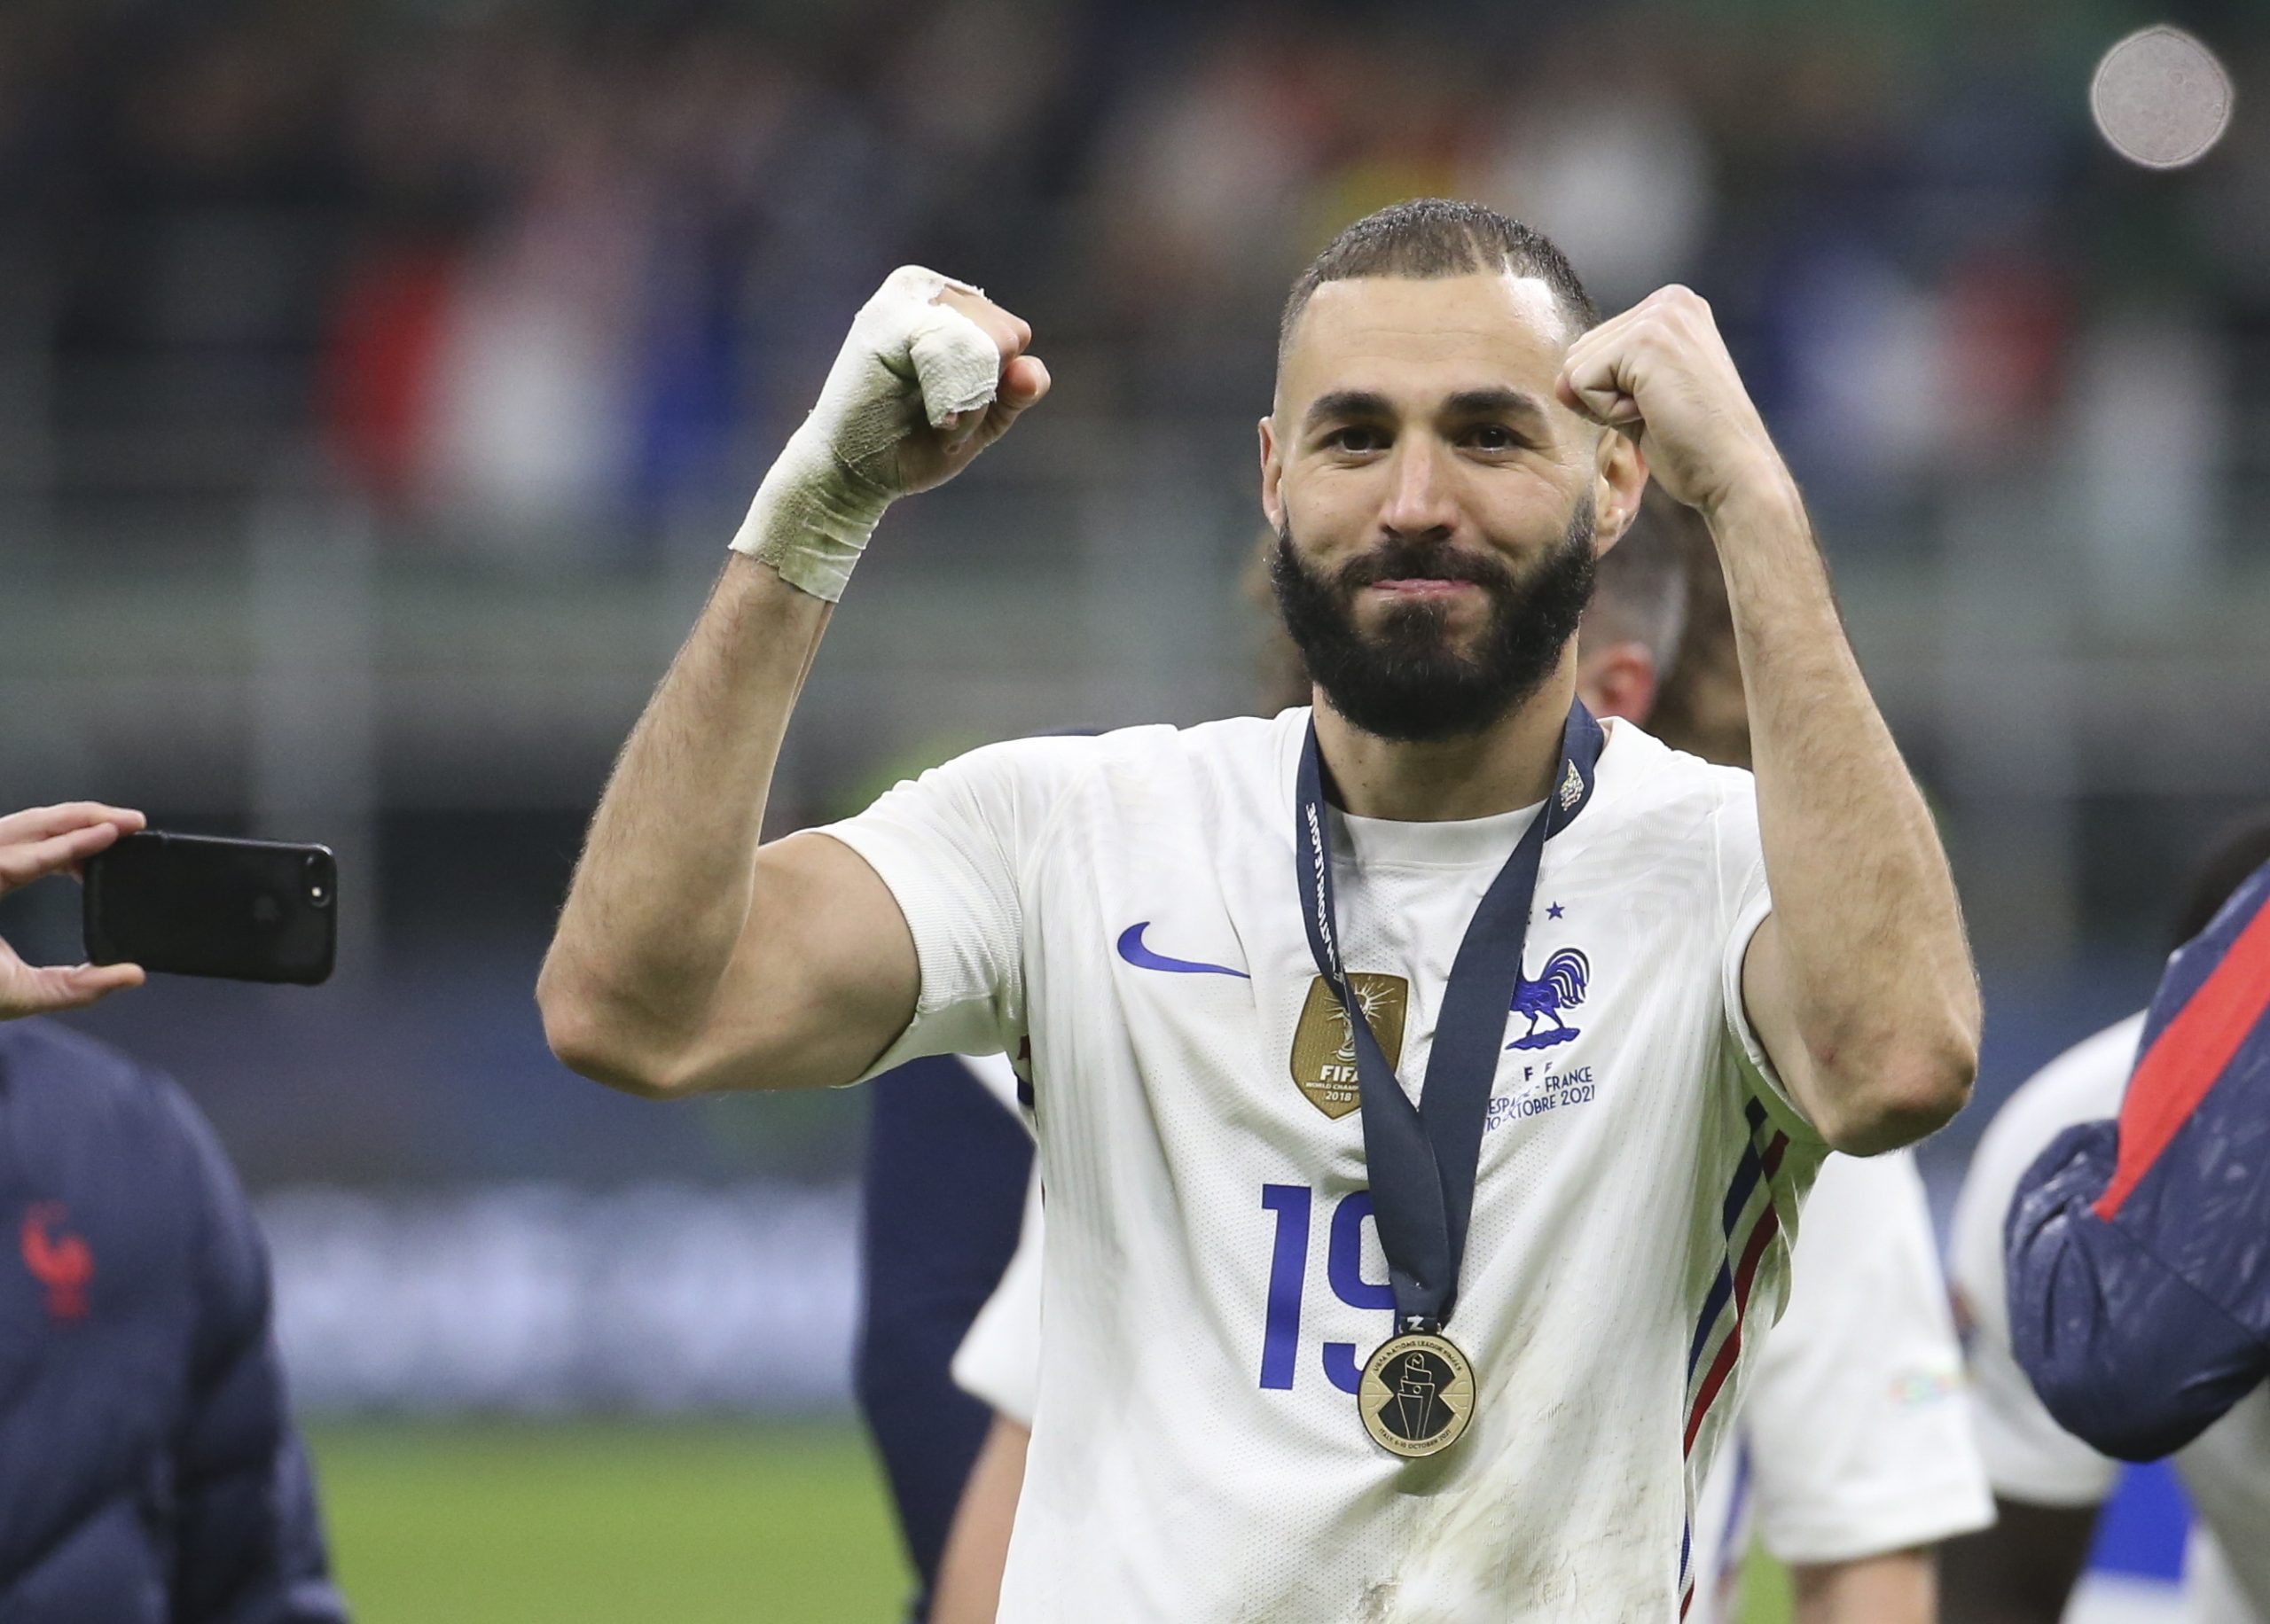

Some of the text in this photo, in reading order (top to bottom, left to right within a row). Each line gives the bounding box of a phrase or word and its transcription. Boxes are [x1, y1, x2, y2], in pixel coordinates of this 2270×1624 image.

[1305, 801, 1325, 877] LEAGUE
[1545, 1066, 1593, 1093] FRANCE
[1325, 1090, 1353, 1102] 2018
[1561, 1084, 1595, 1107] 2021
[1259, 1183, 1399, 1395] 19
